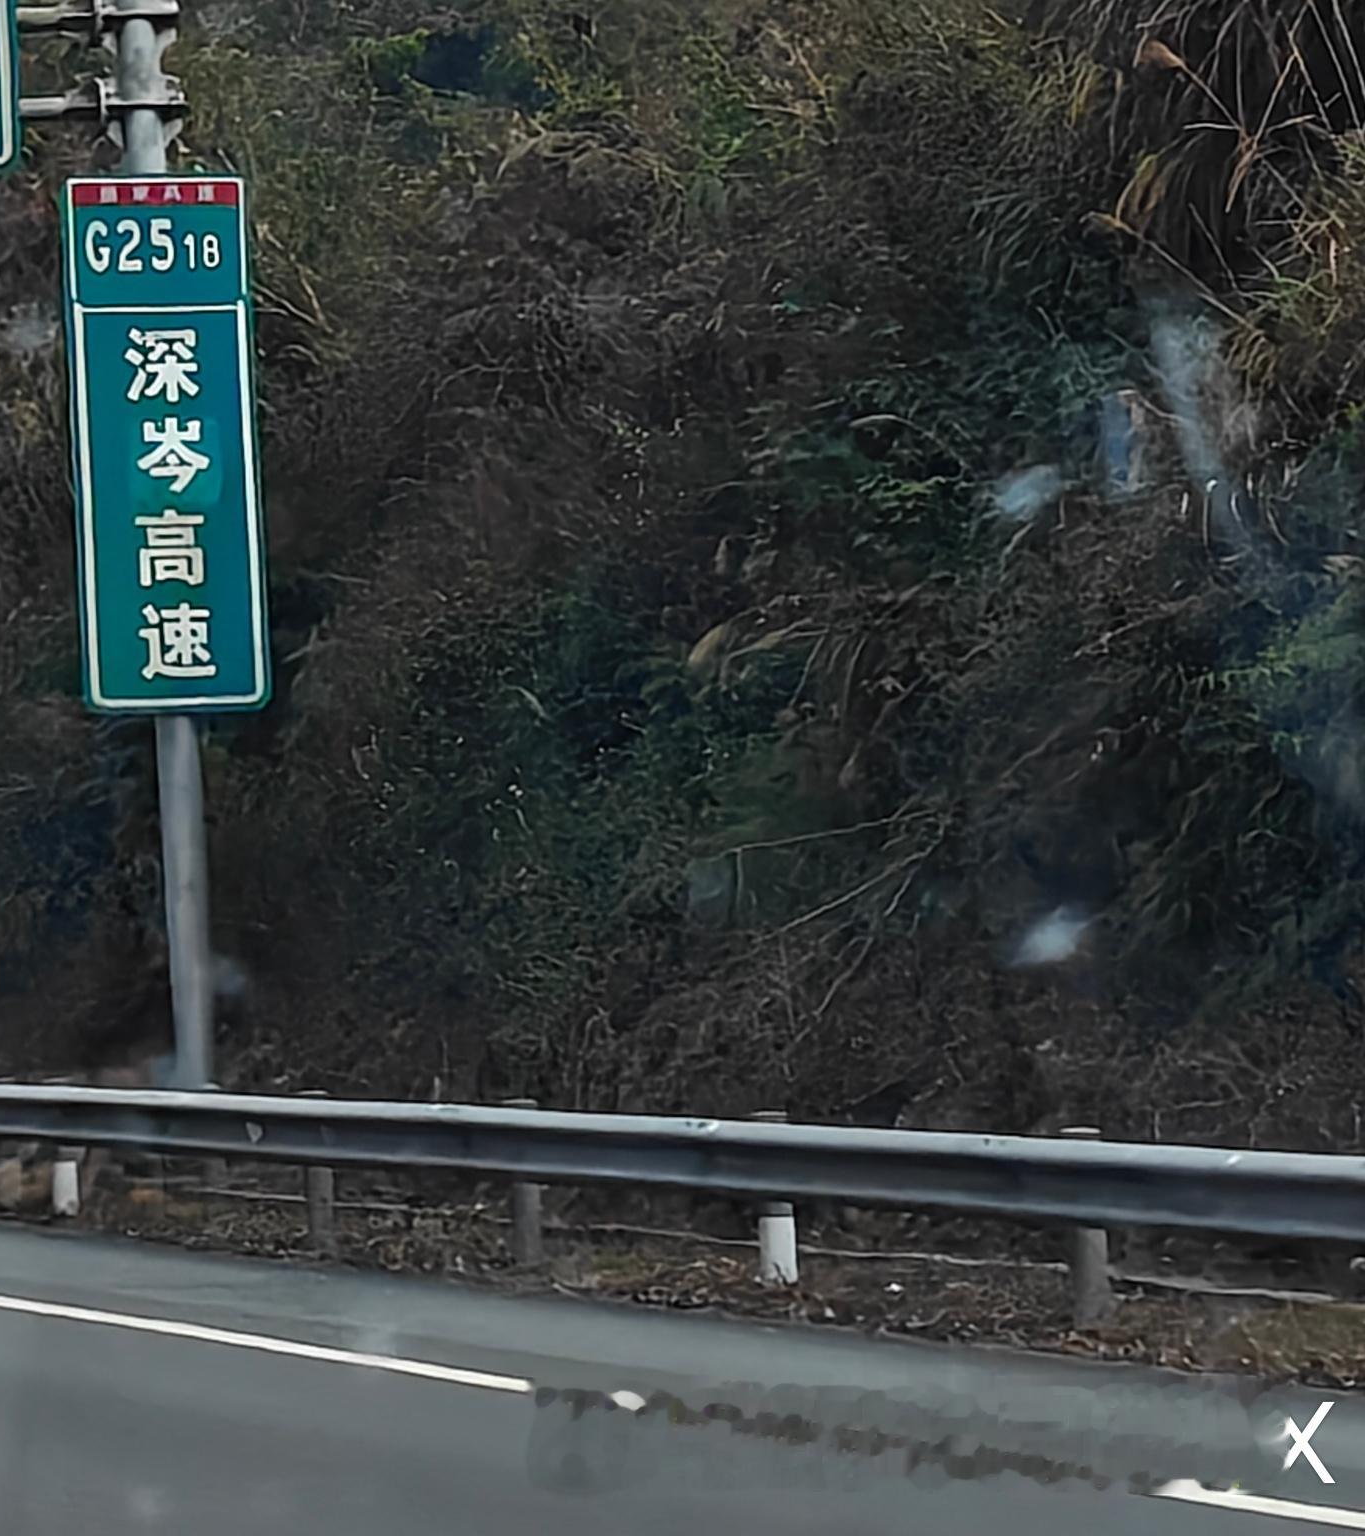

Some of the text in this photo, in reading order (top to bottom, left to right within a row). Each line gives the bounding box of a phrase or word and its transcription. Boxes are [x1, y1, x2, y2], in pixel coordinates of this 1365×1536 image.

[85, 218, 220, 273] G2518
[124, 328, 217, 681] 深岑高速
